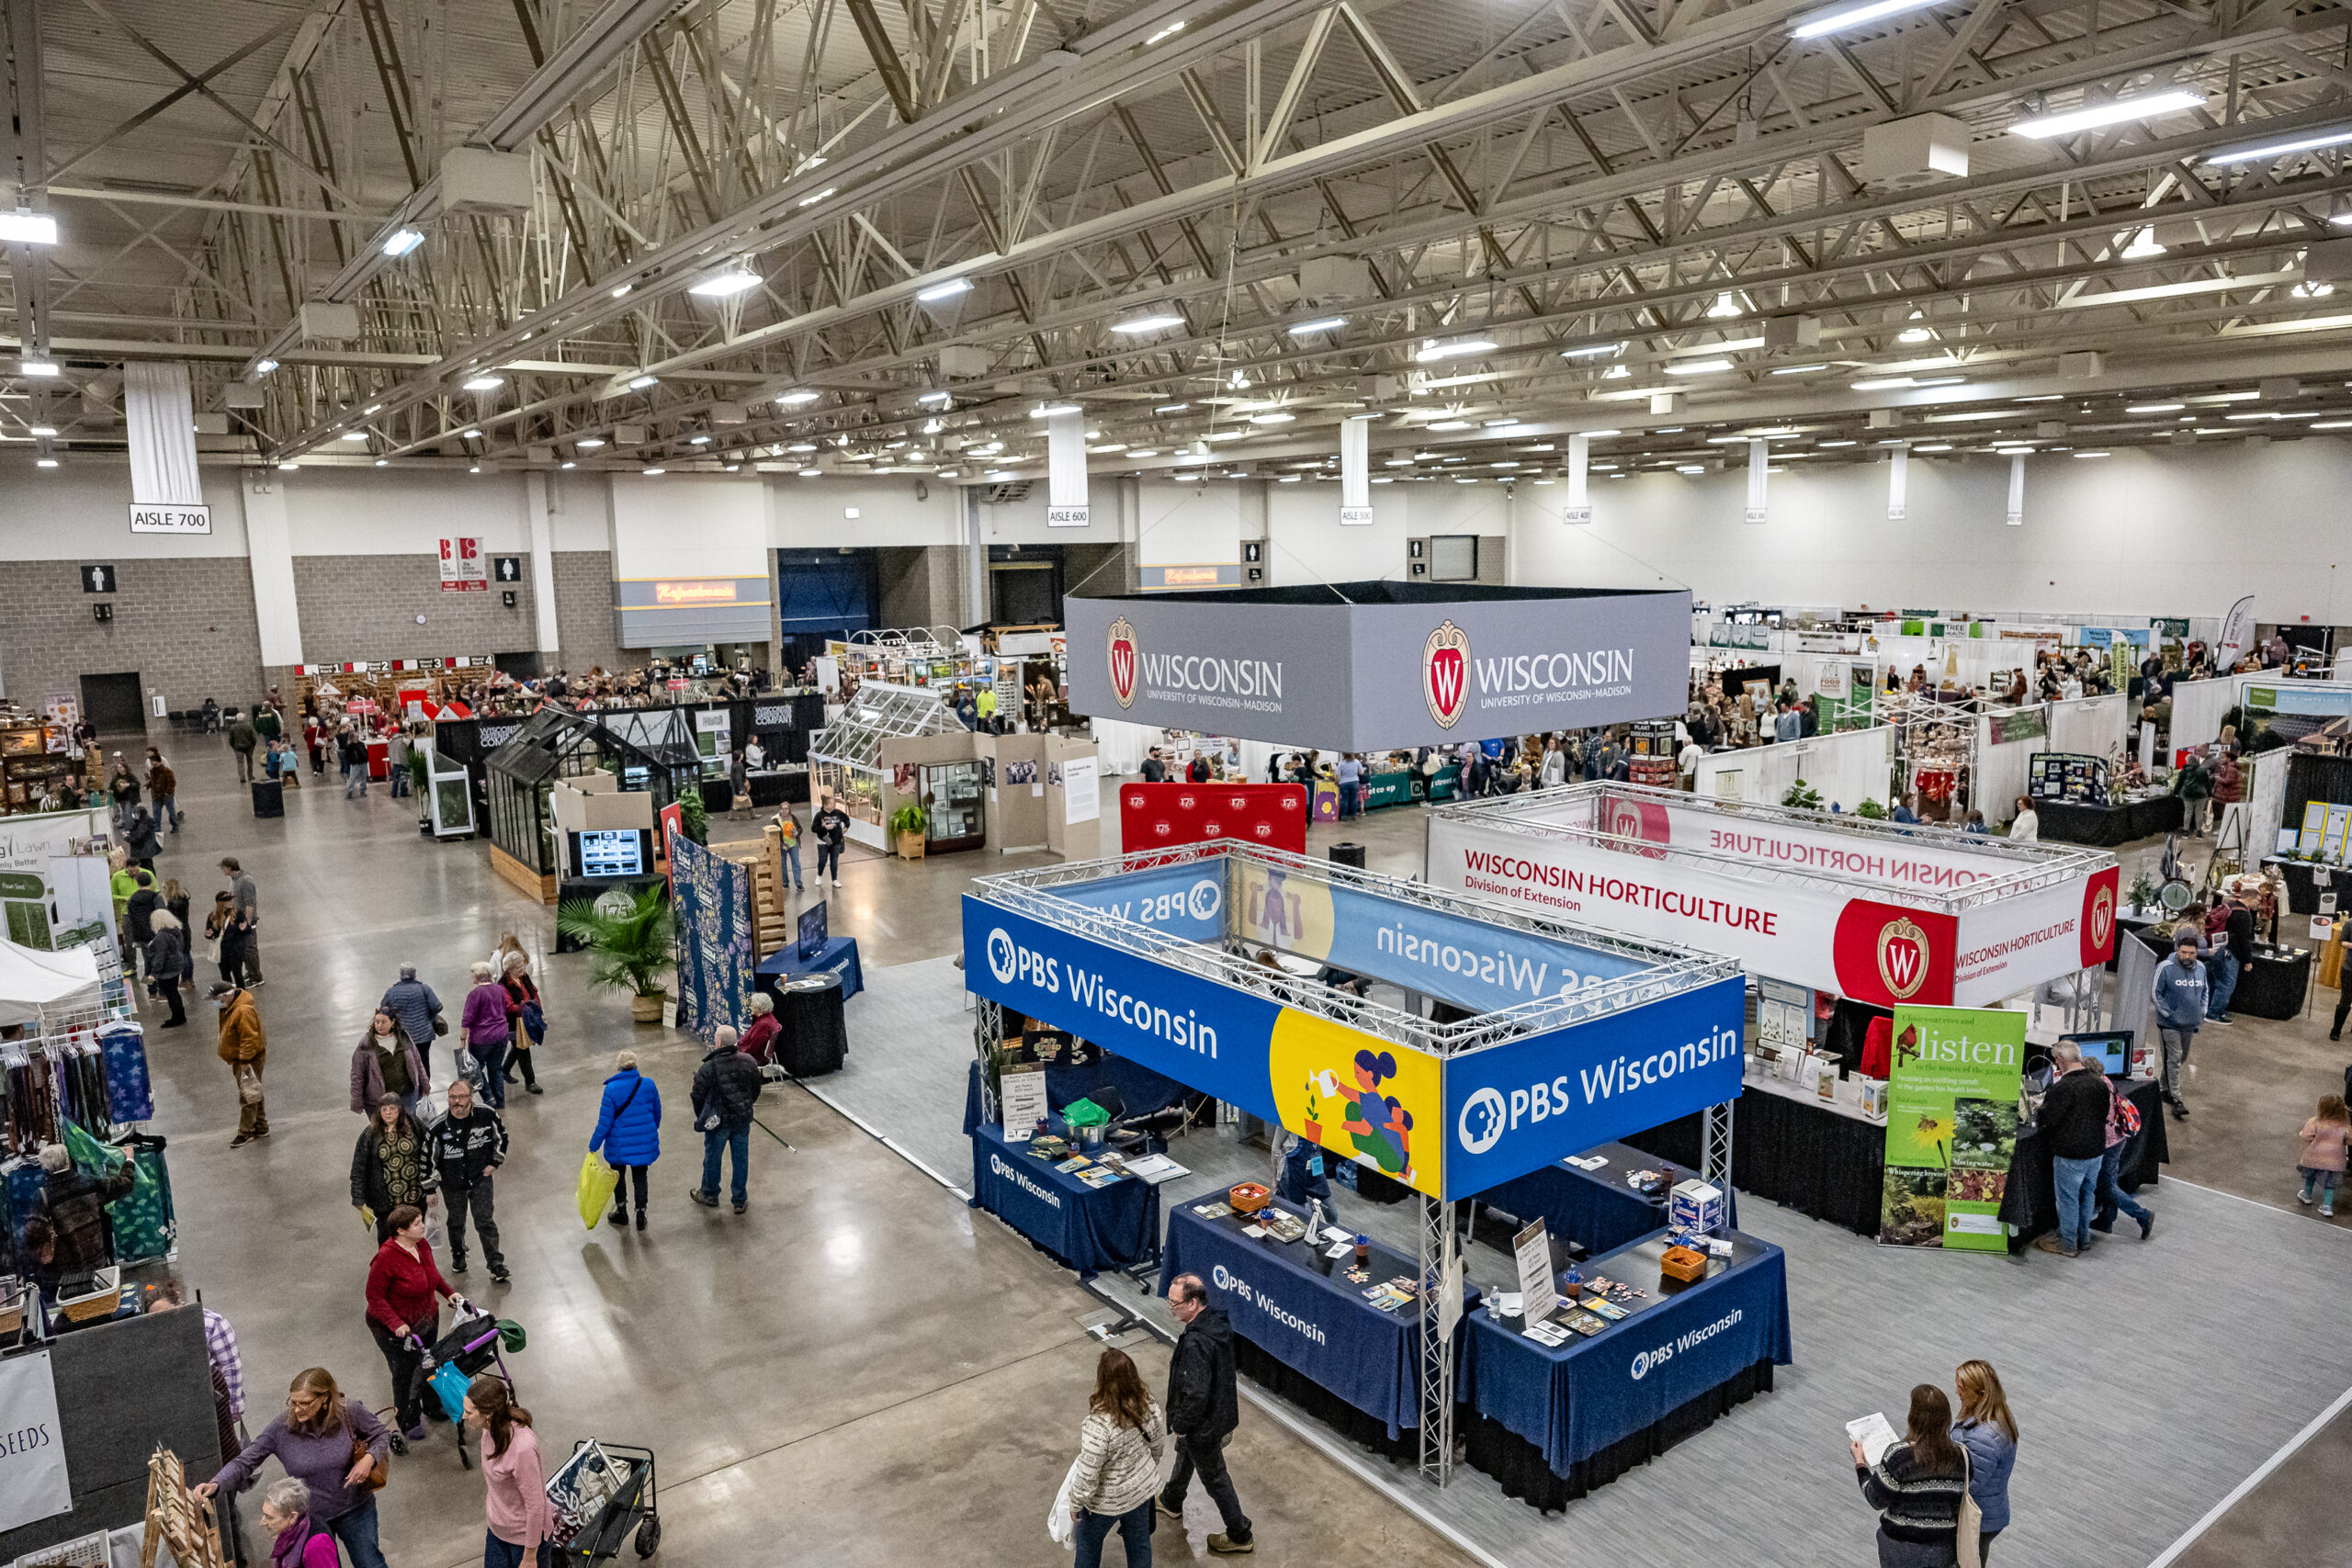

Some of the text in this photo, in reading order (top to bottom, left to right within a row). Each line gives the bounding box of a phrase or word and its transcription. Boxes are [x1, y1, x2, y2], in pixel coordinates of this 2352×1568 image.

[134, 513, 205, 527] AISLE 700
[1049, 511, 1087, 522] AISLE 600
[1566, 512, 1579, 520] AISLE
[381, 661, 390, 671] 2
[434, 658, 441, 669] 3
[485, 656, 492, 666] 4
[333, 663, 341, 673] 1
[1476, 649, 1634, 694] WISCONSIN
[1141, 652, 1283, 698] WISCONSIN
[1147, 689, 1186, 703] UNIVERSITY
[1187, 693, 1196, 704] OF
[1481, 694, 1531, 709] UNIVERSITY
[1532, 693, 1544, 705] OF
[755, 705, 792, 714] WISCONSIN
[755, 716, 792, 726] COMPANY
[1434, 778, 1453, 786] street
[1376, 784, 1396, 795] co-op
[1130, 797, 1145, 807] 175
[1180, 797, 1194, 807] 175
[1231, 797, 1246, 807] 175
[1283, 797, 1297, 808] 175
[1156, 823, 1170, 833] 175
[1205, 824, 1220, 834] 175
[1257, 825, 1271, 834] 175
[17, 840, 51, 854] Lawn
[14, 858, 38, 867] Better
[1464, 849, 1778, 936] WISCONSIN HORTICULTURE
[1464, 875, 1581, 912] Division of Extension
[1955, 919, 2075, 970] WISCONSIN HORTICULTURE
[1954, 961, 2007, 985] Division of Extension
[1018, 945, 1217, 1060] PBS Wisconsin
[1961, 1017, 1974, 1025] and
[1917, 1027, 2017, 1066] listen
[1510, 1024, 1736, 1131] PBS Wisconsin
[1897, 1075, 1923, 1084] Focusing
[1931, 1077, 1957, 1086] soothing
[1915, 1086, 1935, 1095] garden
[1953, 1158, 1976, 1168] Moving
[1887, 1167, 1947, 1178] Whispering breezes
[1001, 1162, 1060, 1209] PBS Wisconsin
[1229, 1275, 1327, 1347] PBS Wisconsin
[1648, 1308, 1742, 1369] PBS Wisconsin
[0, 1424, 50, 1459] SEEDS
